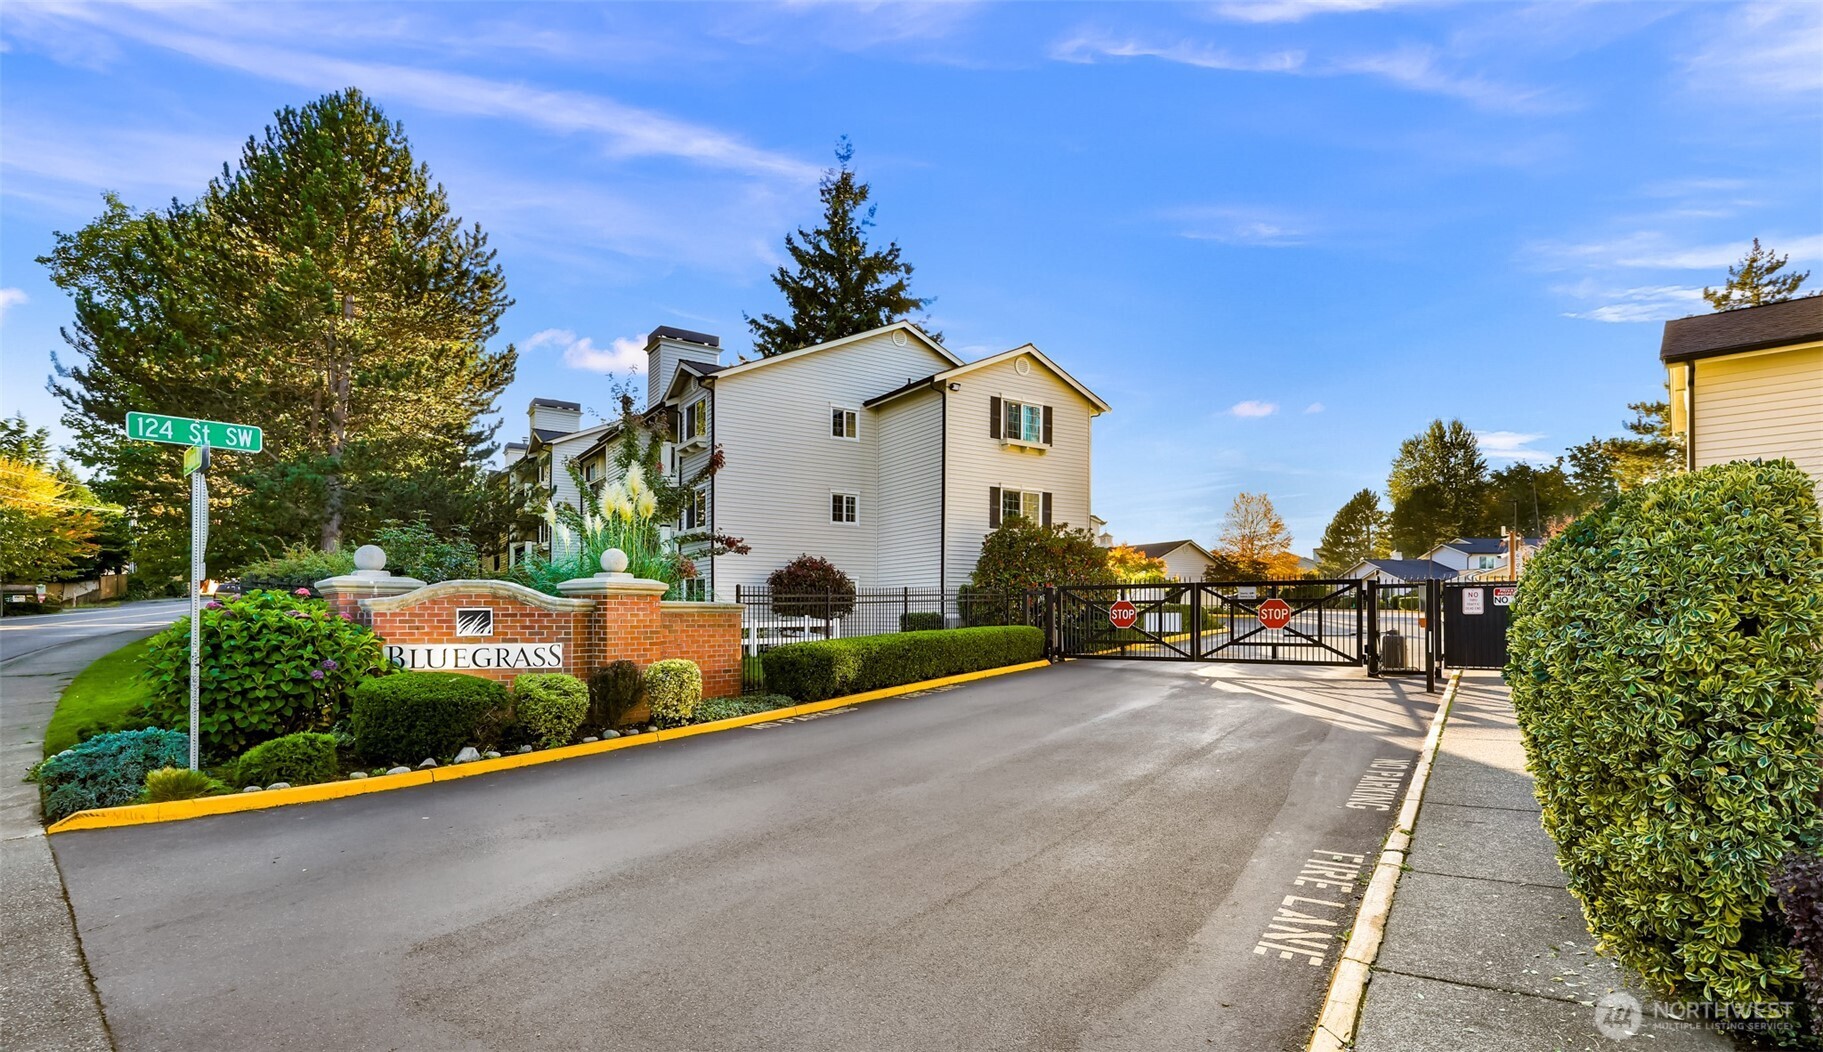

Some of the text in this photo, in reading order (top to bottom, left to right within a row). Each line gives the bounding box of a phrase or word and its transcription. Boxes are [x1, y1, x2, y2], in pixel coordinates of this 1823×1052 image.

[137, 417, 252, 447] 124 St SW
[1112, 610, 1134, 619] STOP
[1261, 609, 1288, 619] STOP
[387, 644, 561, 668] BLUEGRASS
[1345, 758, 1411, 811] NO PARKING
[1253, 850, 1364, 966] FIRE LANE
